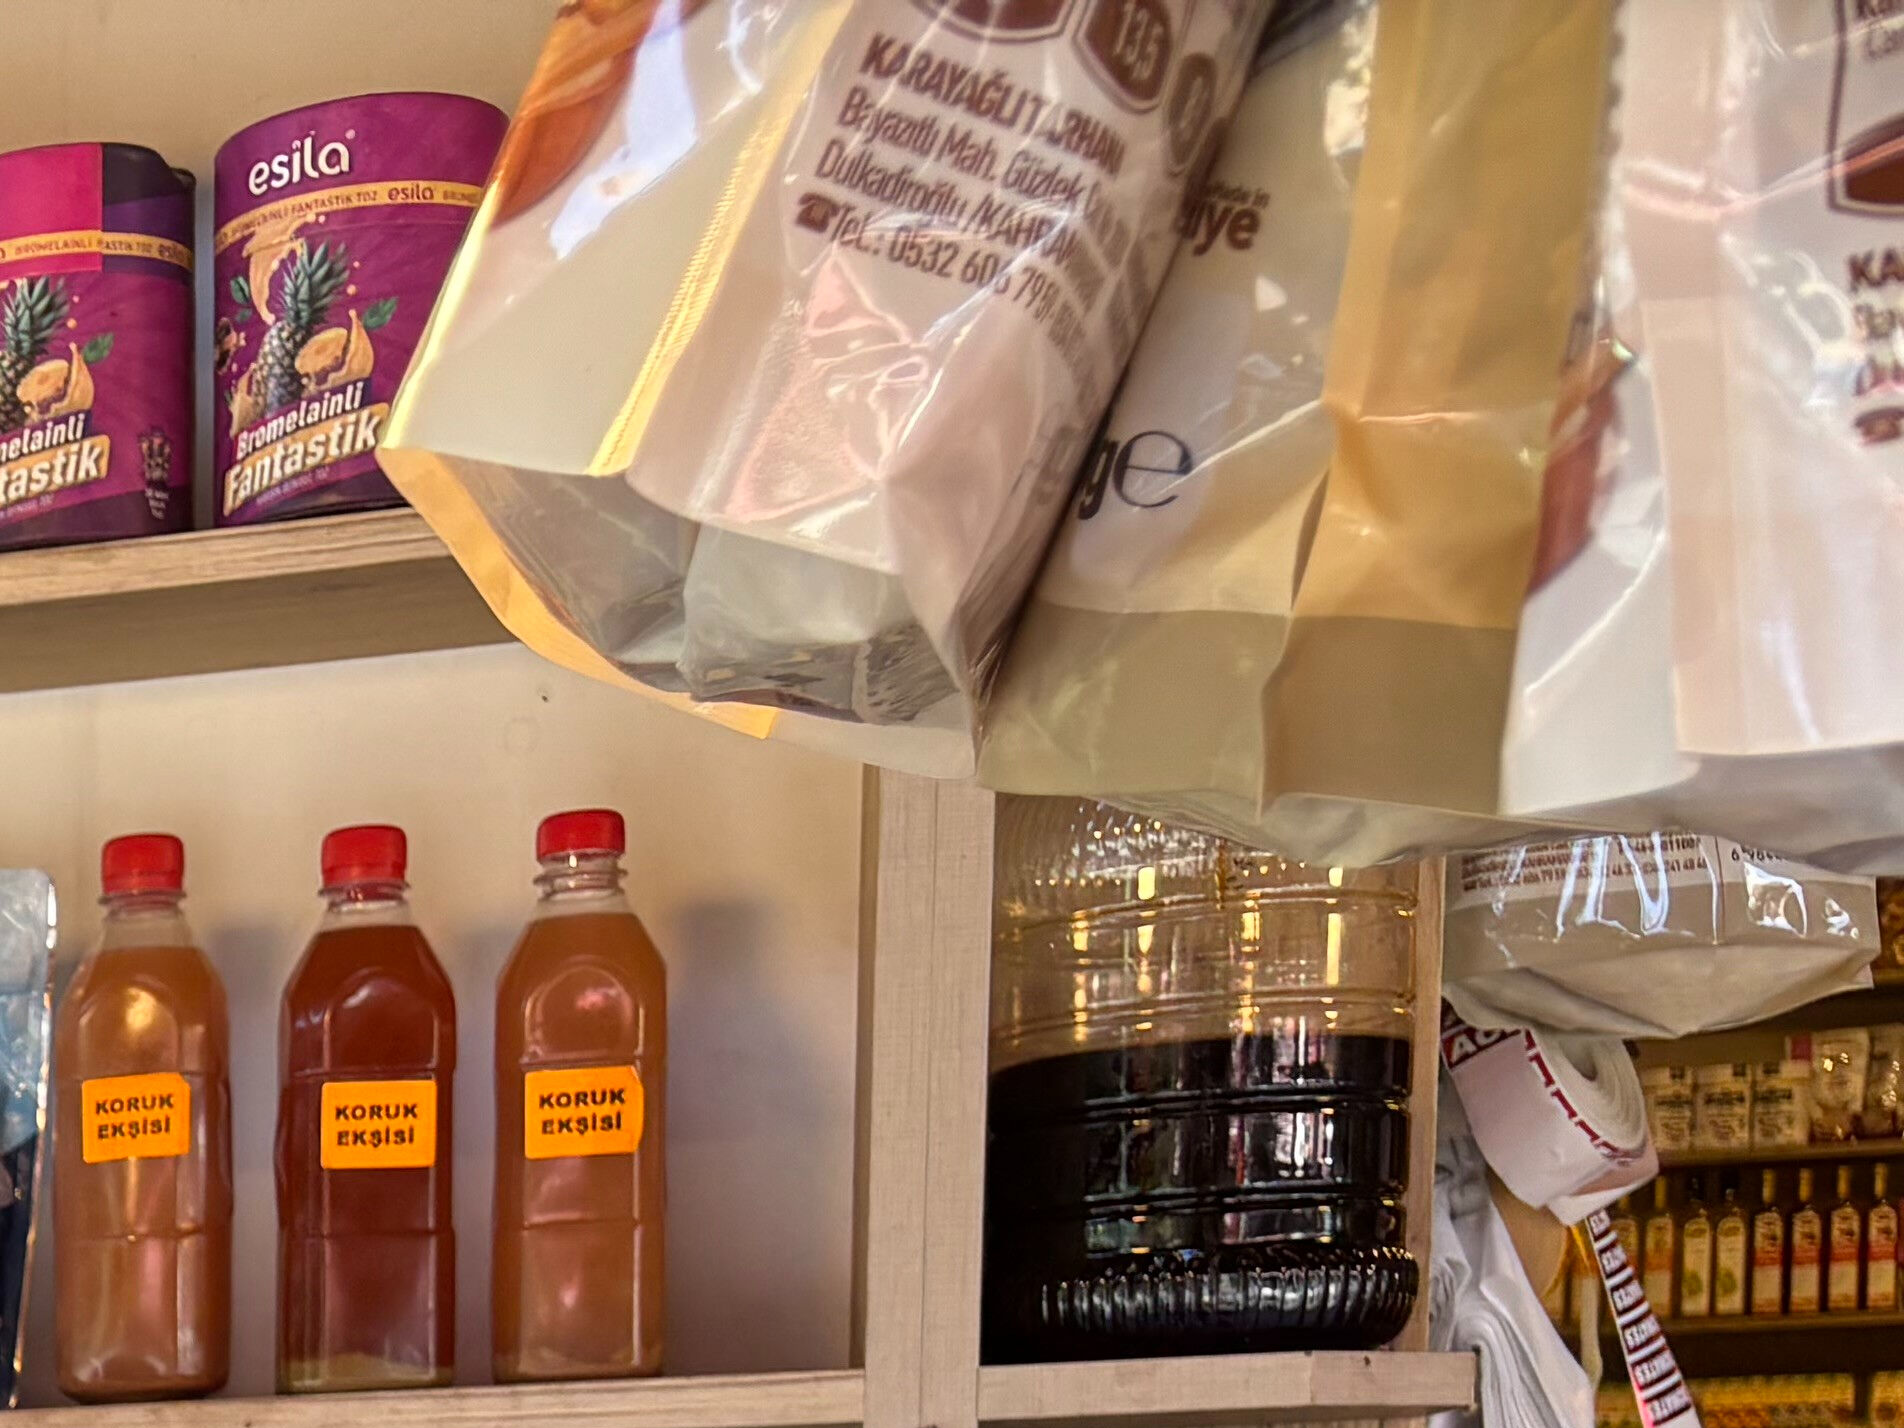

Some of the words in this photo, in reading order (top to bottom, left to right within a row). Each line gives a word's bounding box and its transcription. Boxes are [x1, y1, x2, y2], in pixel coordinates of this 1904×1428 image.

[249, 134, 351, 196] esila
[236, 382, 363, 462] Bromelainli
[224, 412, 380, 510] Fantastik
[94, 1095, 175, 1119] KORUK
[538, 1086, 626, 1111] KORUK
[334, 1103, 420, 1123] KORUK
[541, 1110, 623, 1138] EKŞİSİ
[96, 1116, 172, 1142] EKŞİSİ
[336, 1125, 416, 1150] EKŞİSİ
